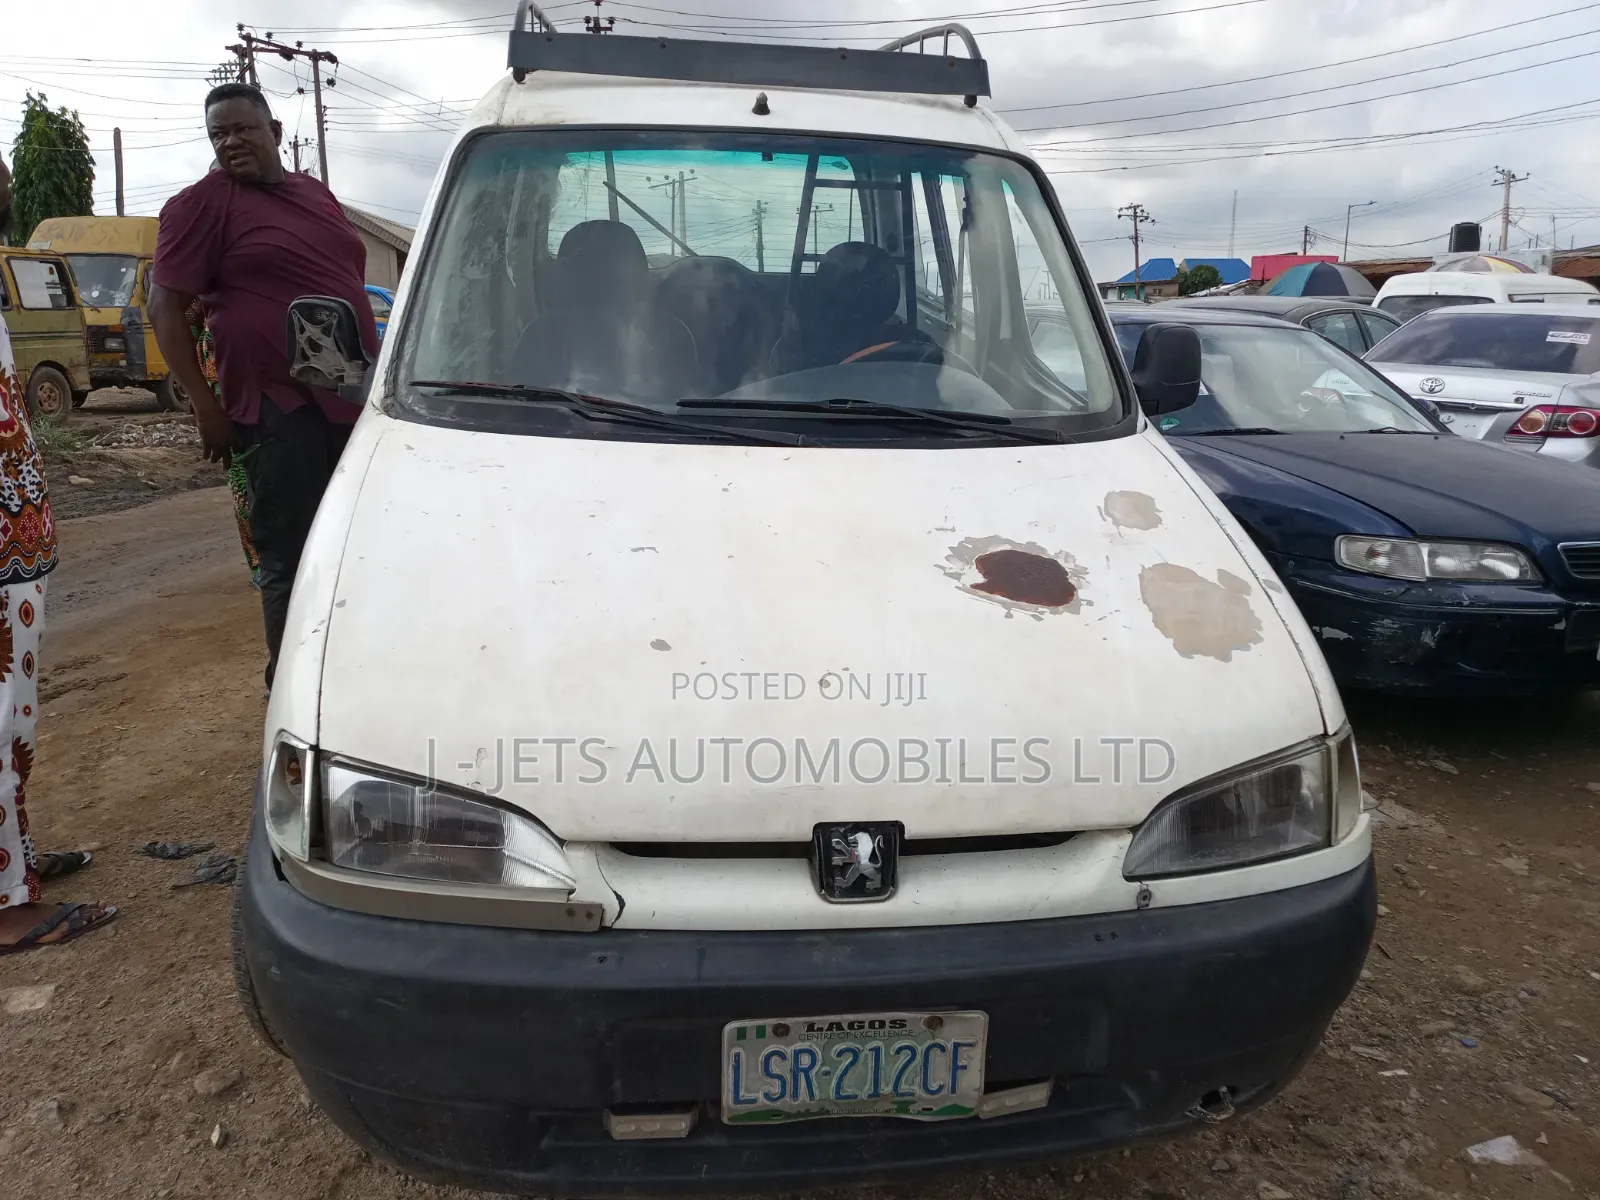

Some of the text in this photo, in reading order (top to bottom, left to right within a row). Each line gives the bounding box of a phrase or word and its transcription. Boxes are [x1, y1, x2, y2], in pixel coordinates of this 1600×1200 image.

[805, 1018, 908, 1033] LAGOS
[798, 1031, 836, 1041] CENTRE
[852, 1029, 914, 1039] EXCELLENCE
[731, 1041, 978, 1106] LSR-212CF
